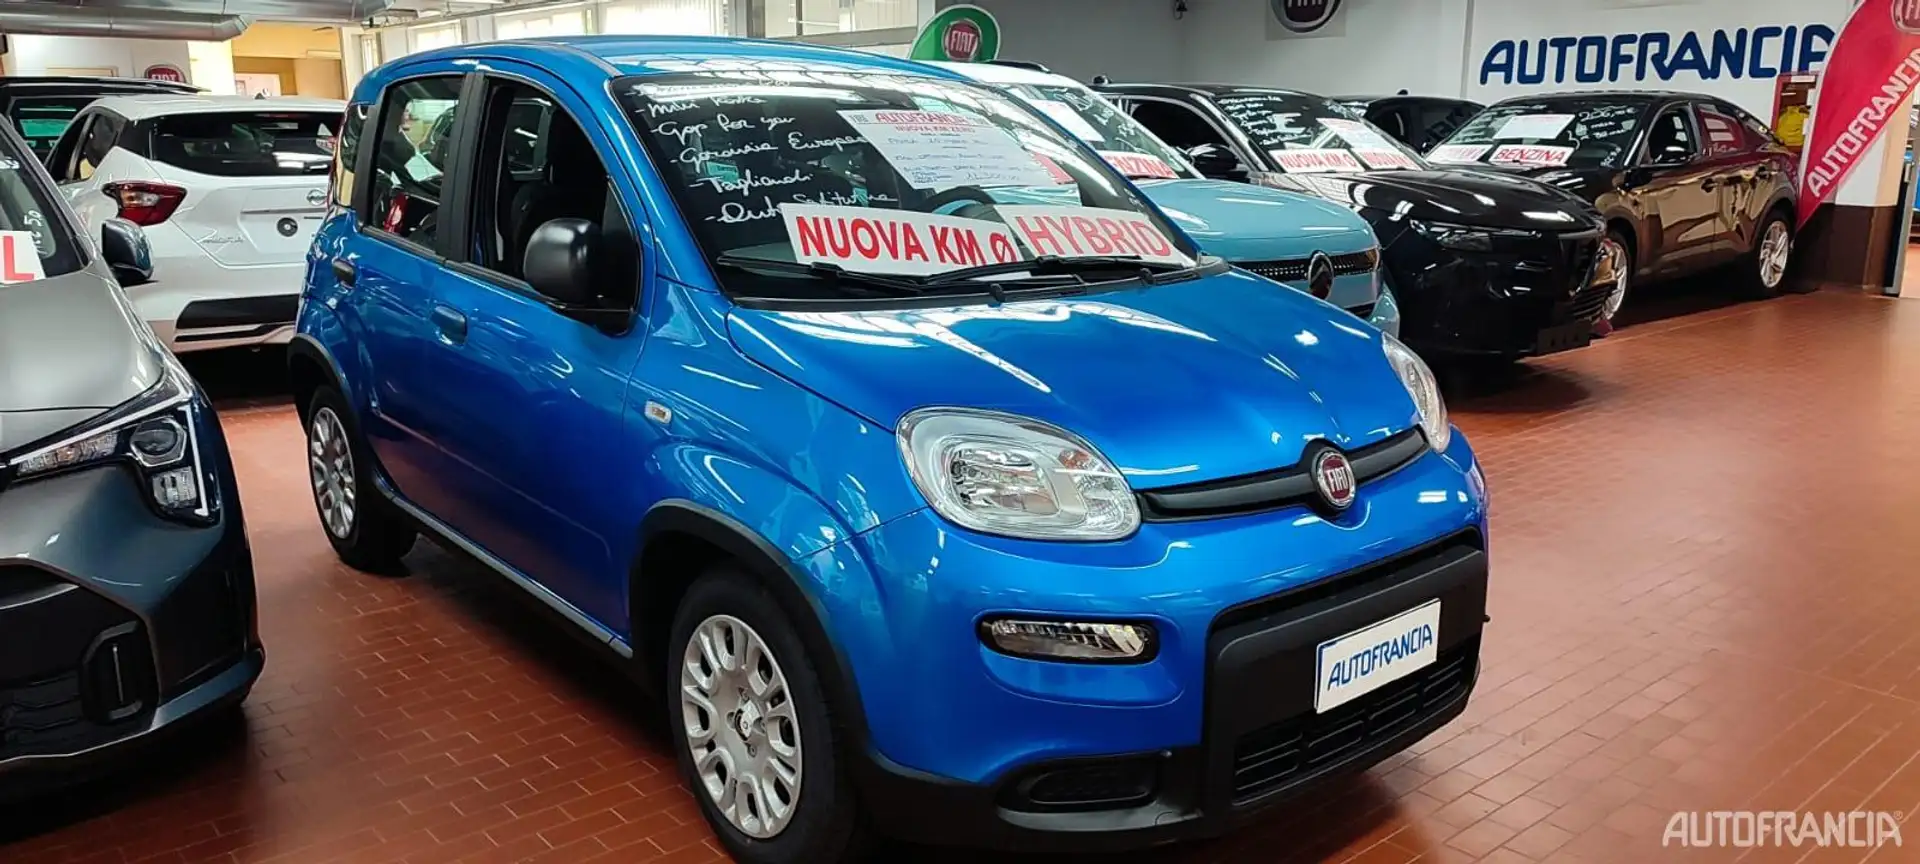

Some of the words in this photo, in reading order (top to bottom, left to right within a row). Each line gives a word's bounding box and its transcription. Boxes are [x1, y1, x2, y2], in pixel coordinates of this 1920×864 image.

[950, 30, 975, 53] FIAT
[1495, 149, 1567, 161] BENZINA
[796, 216, 930, 263] NUOVA
[929, 224, 987, 267] KM
[1015, 216, 1172, 257] HYBRID
[1326, 466, 1349, 493] FIAT
[1327, 623, 1433, 691] AUTOFRANCIA
